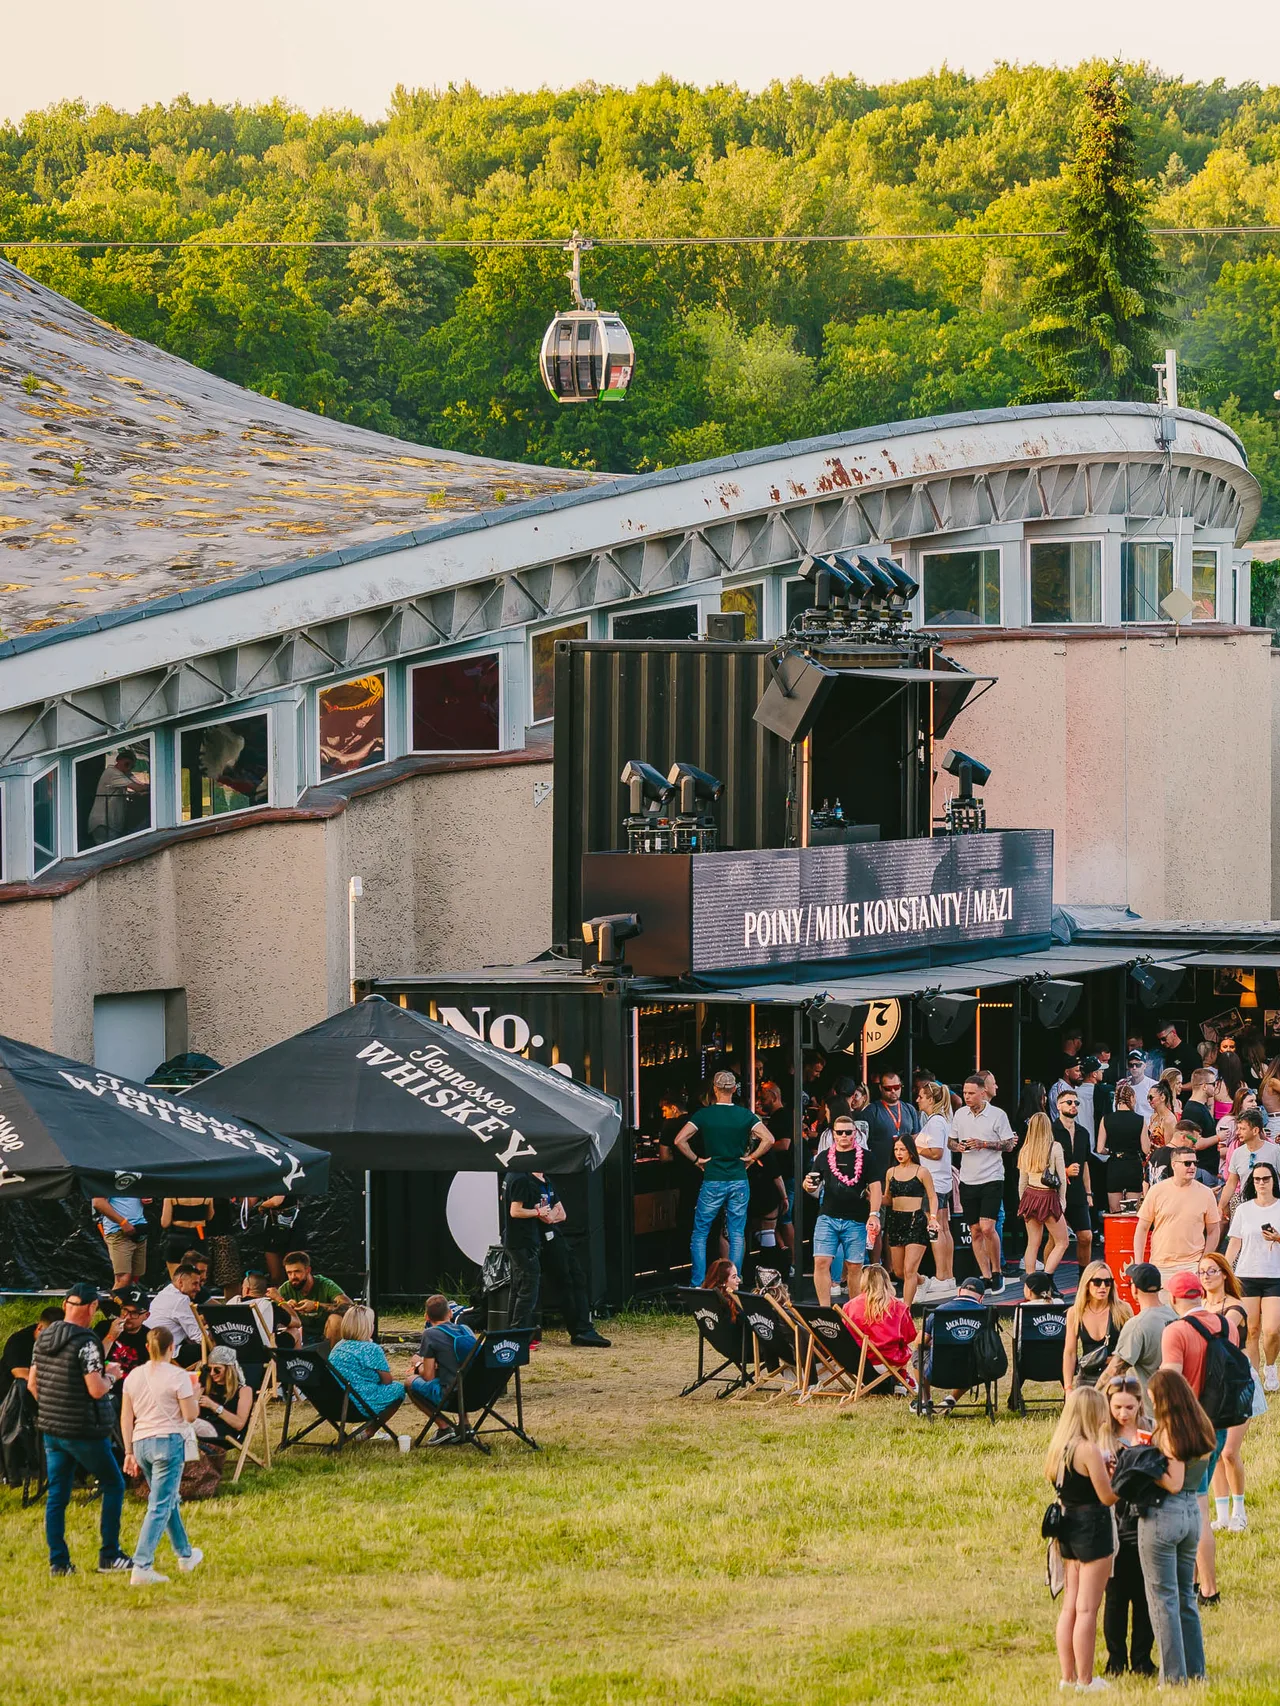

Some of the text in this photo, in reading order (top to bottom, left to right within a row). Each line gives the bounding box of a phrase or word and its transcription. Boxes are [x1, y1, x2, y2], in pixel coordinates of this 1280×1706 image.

[815, 902, 861, 941] MIKE
[863, 892, 963, 935] KONSTANTY
[973, 887, 1013, 924] MAZI
[438, 1006, 544, 1054] No.
[95, 1072, 257, 1141] Tennessee
[355, 1040, 538, 1168] WHISKEY
[409, 1044, 516, 1117] Tennessee
[57, 1070, 306, 1191] WHISKEY
[945, 1319, 960, 1331] JACK
